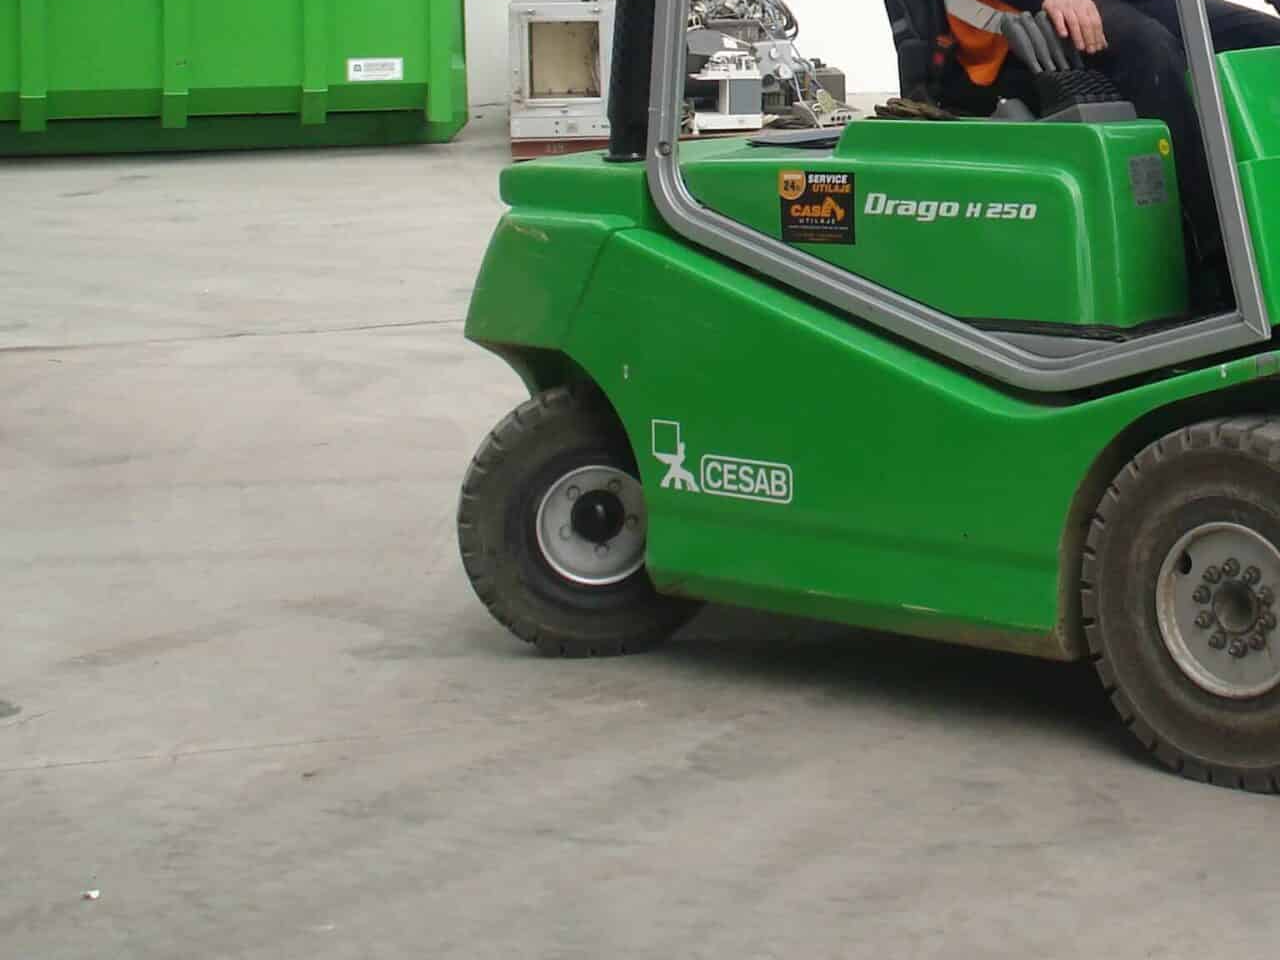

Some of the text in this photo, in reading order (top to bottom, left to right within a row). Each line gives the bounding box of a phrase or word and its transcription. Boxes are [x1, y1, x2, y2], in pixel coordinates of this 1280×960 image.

[807, 173, 848, 184] SERVICE
[790, 204, 832, 217] CASE
[864, 193, 1037, 222] Drago H 250
[706, 461, 787, 497] CESAB
